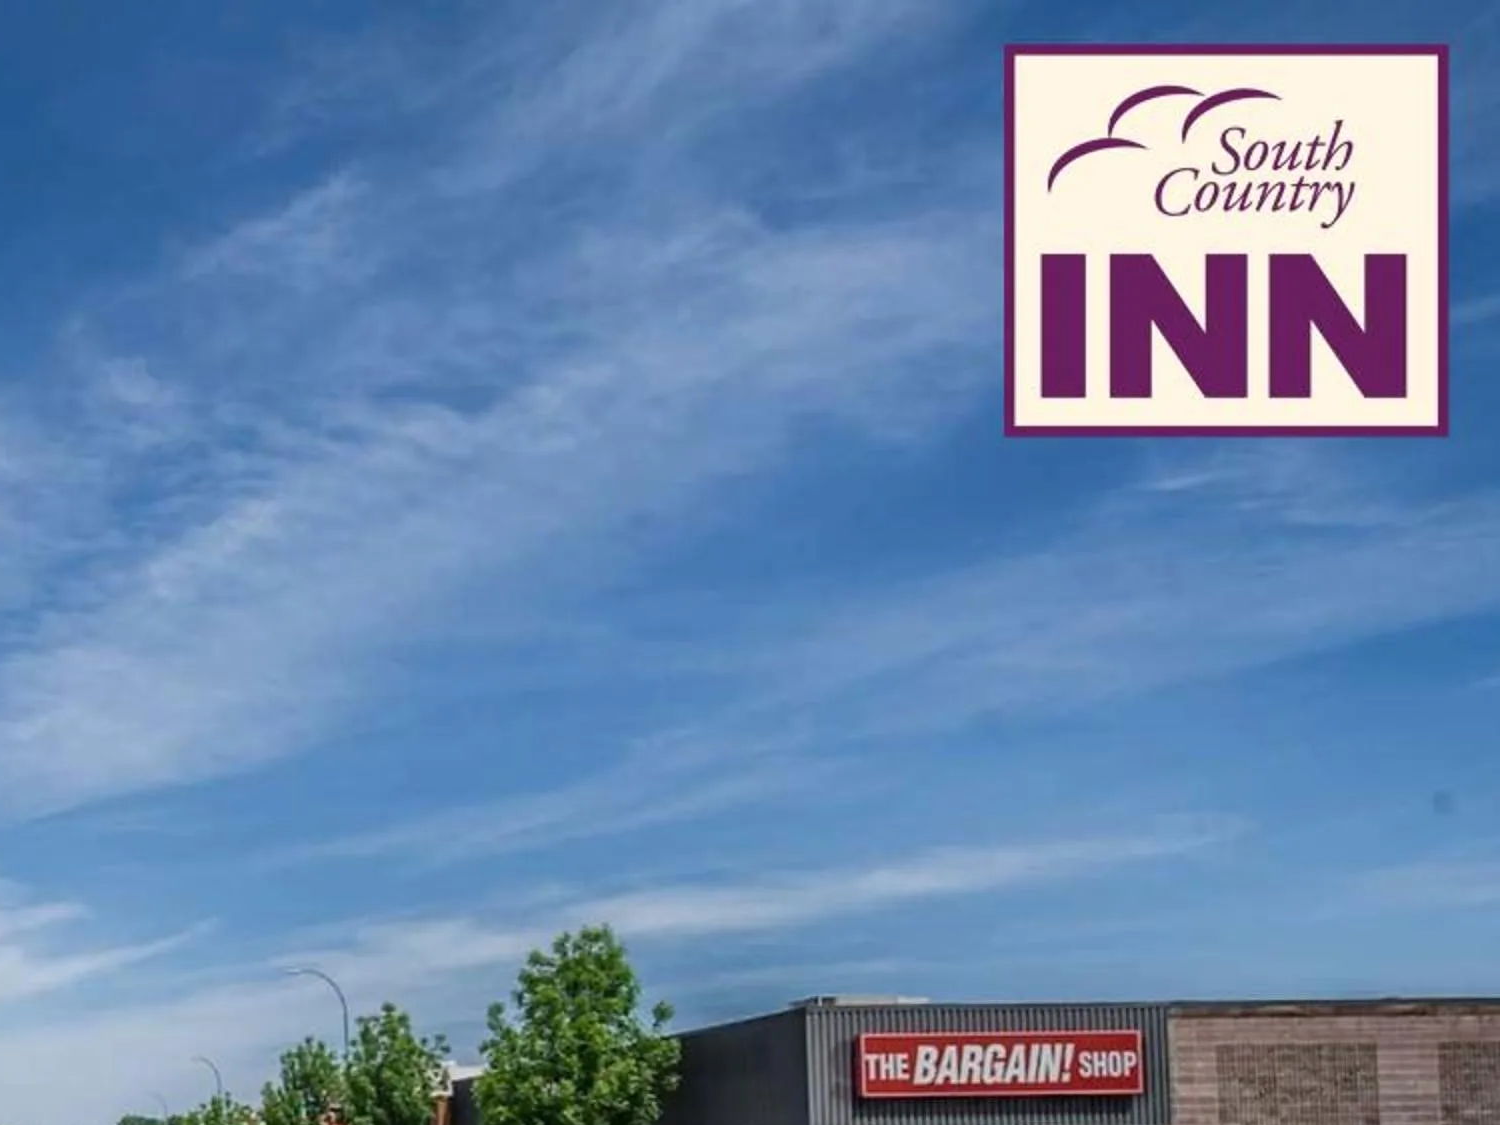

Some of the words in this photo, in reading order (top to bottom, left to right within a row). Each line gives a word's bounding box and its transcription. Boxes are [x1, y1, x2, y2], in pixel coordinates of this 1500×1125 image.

[864, 1053, 910, 1080] THE
[912, 1043, 1076, 1085] BARGAIN!
[1078, 1051, 1138, 1078] SHOP
